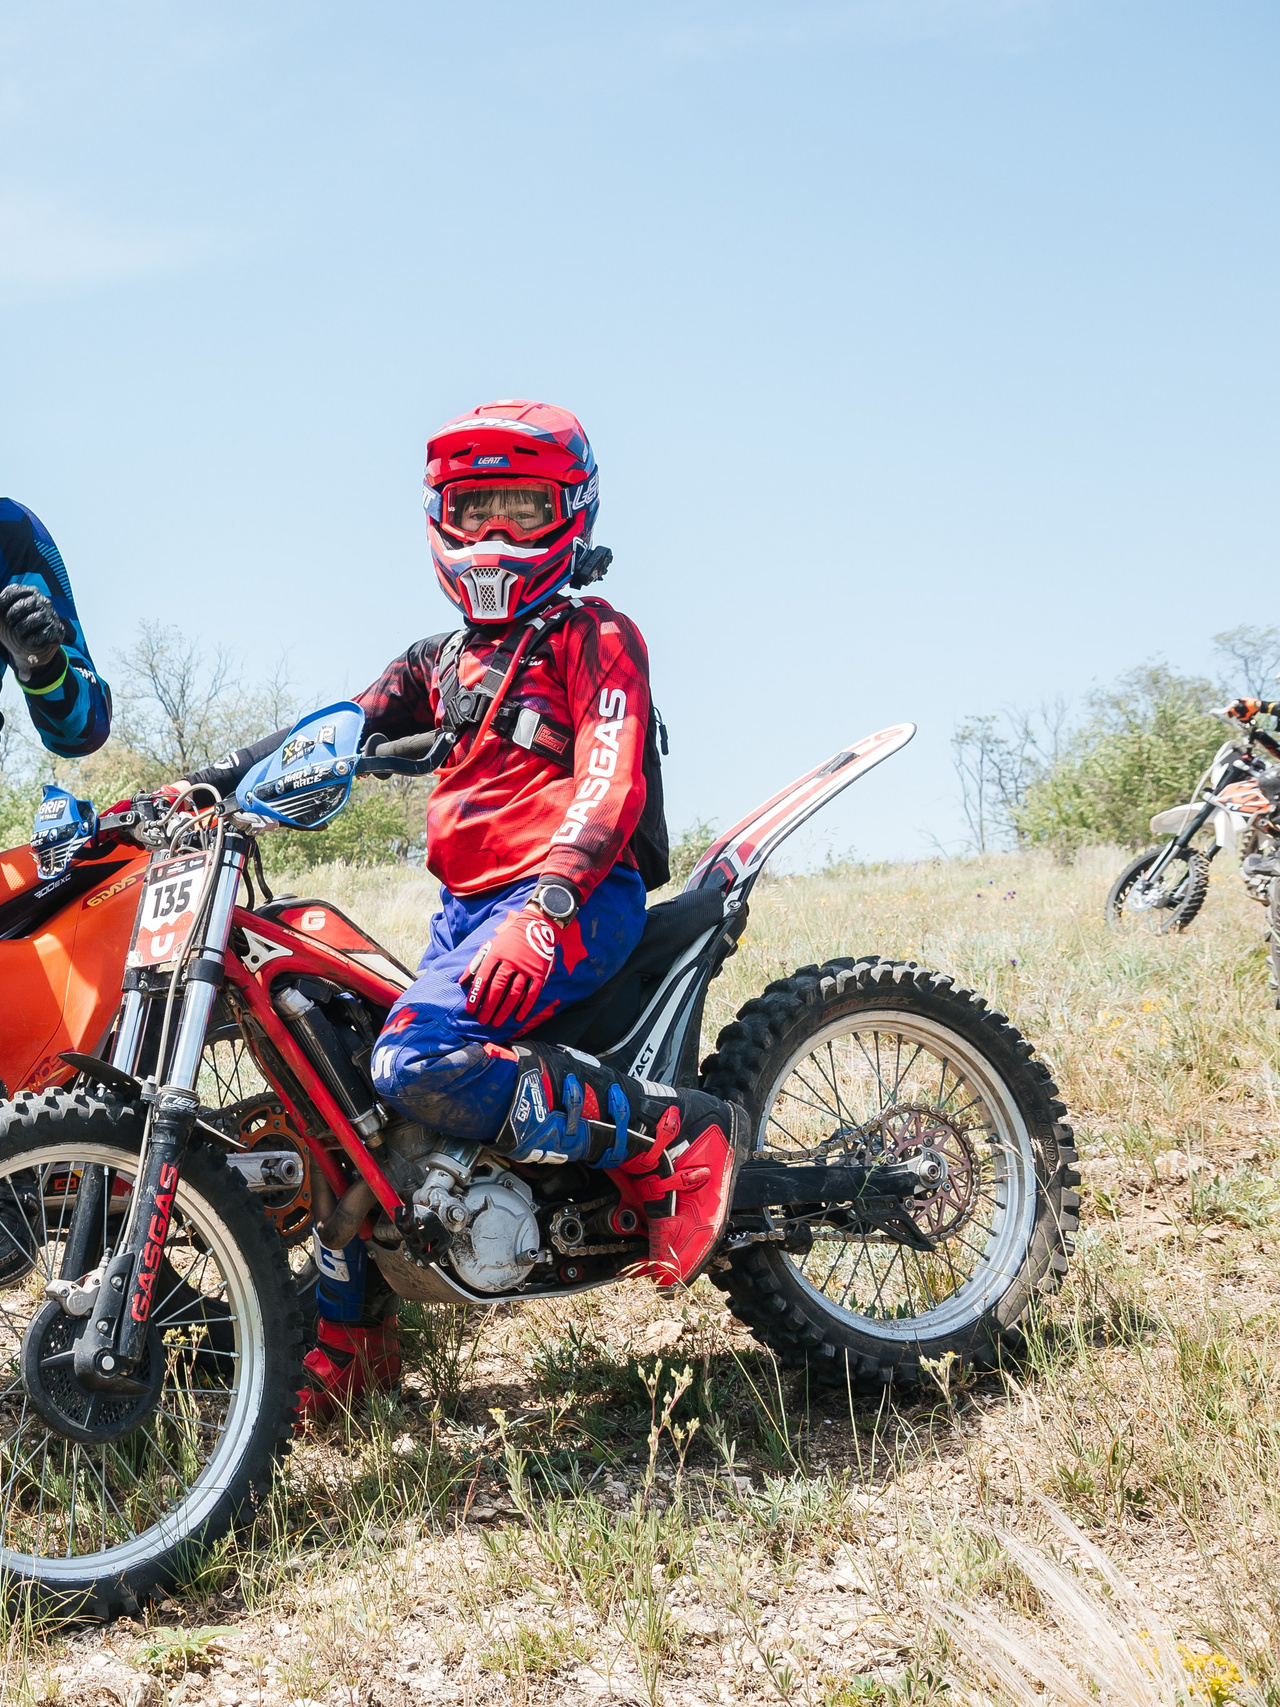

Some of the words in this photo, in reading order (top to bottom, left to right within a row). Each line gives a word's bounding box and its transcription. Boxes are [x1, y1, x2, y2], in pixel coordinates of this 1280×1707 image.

[478, 456, 503, 465] LEATT
[549, 687, 628, 844] GASGAS
[293, 775, 322, 789] RACE
[86, 876, 137, 907] 6DAYS
[152, 878, 194, 919] 135
[300, 910, 326, 931] G
[469, 977, 483, 1004] GIYO
[131, 1162, 178, 1321] GASGAS
